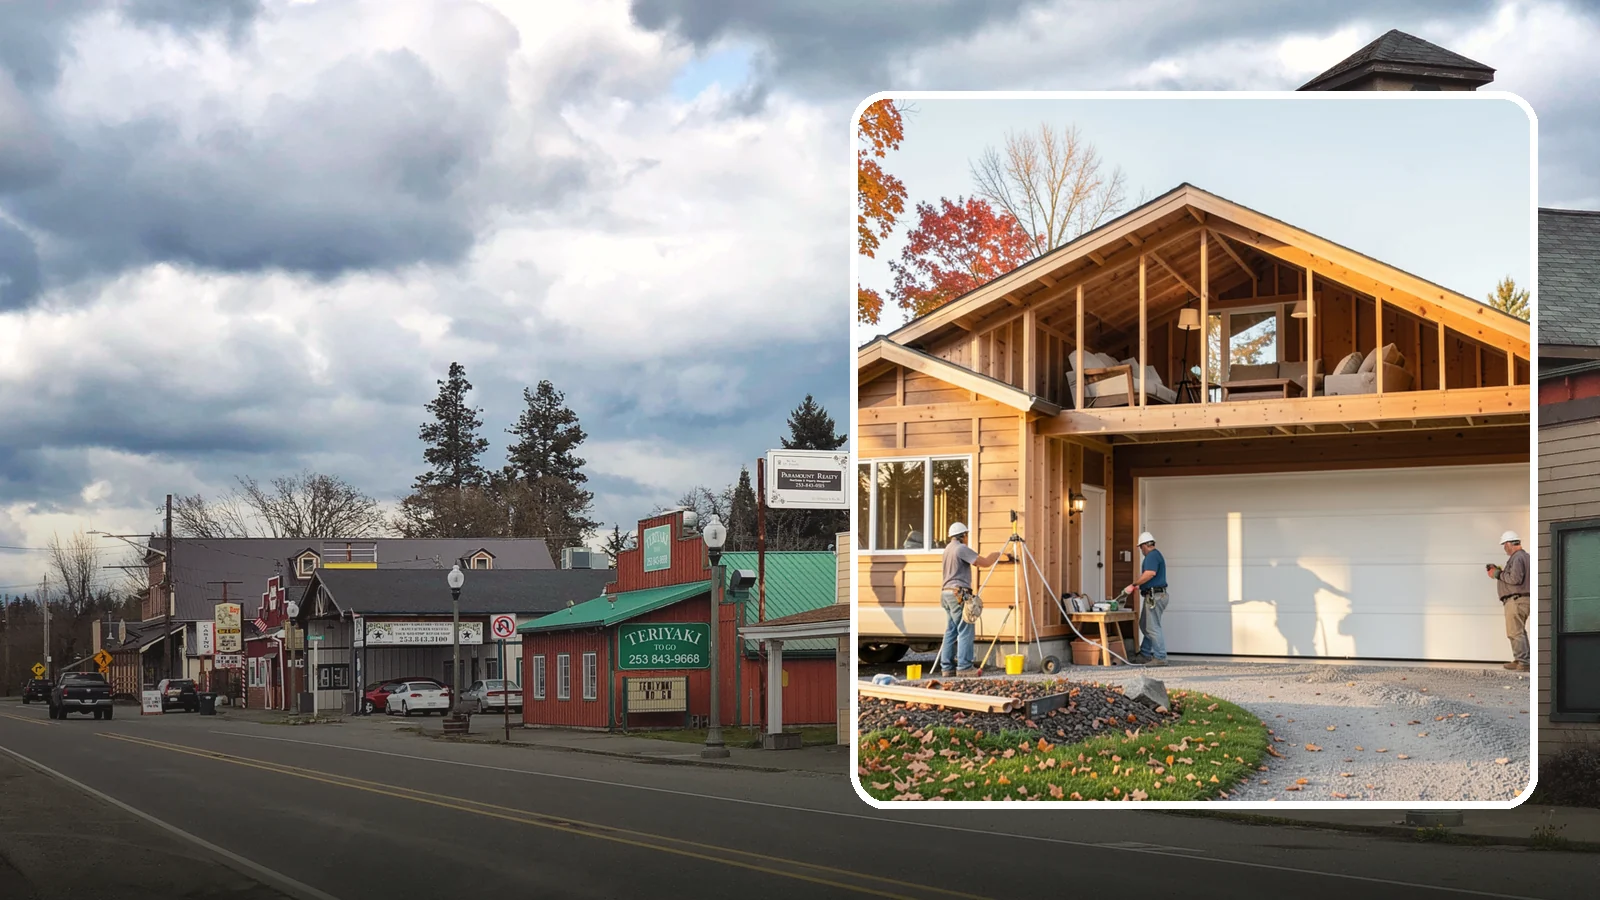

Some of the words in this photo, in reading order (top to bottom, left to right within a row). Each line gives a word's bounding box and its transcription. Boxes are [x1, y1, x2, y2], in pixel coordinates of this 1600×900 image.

[817, 472, 839, 480] REALTY
[624, 627, 702, 646] TERIYAKI
[653, 643, 664, 651] TO
[665, 643, 677, 651] GO
[628, 654, 649, 665] 253
[651, 653, 700, 664] 843-9668
